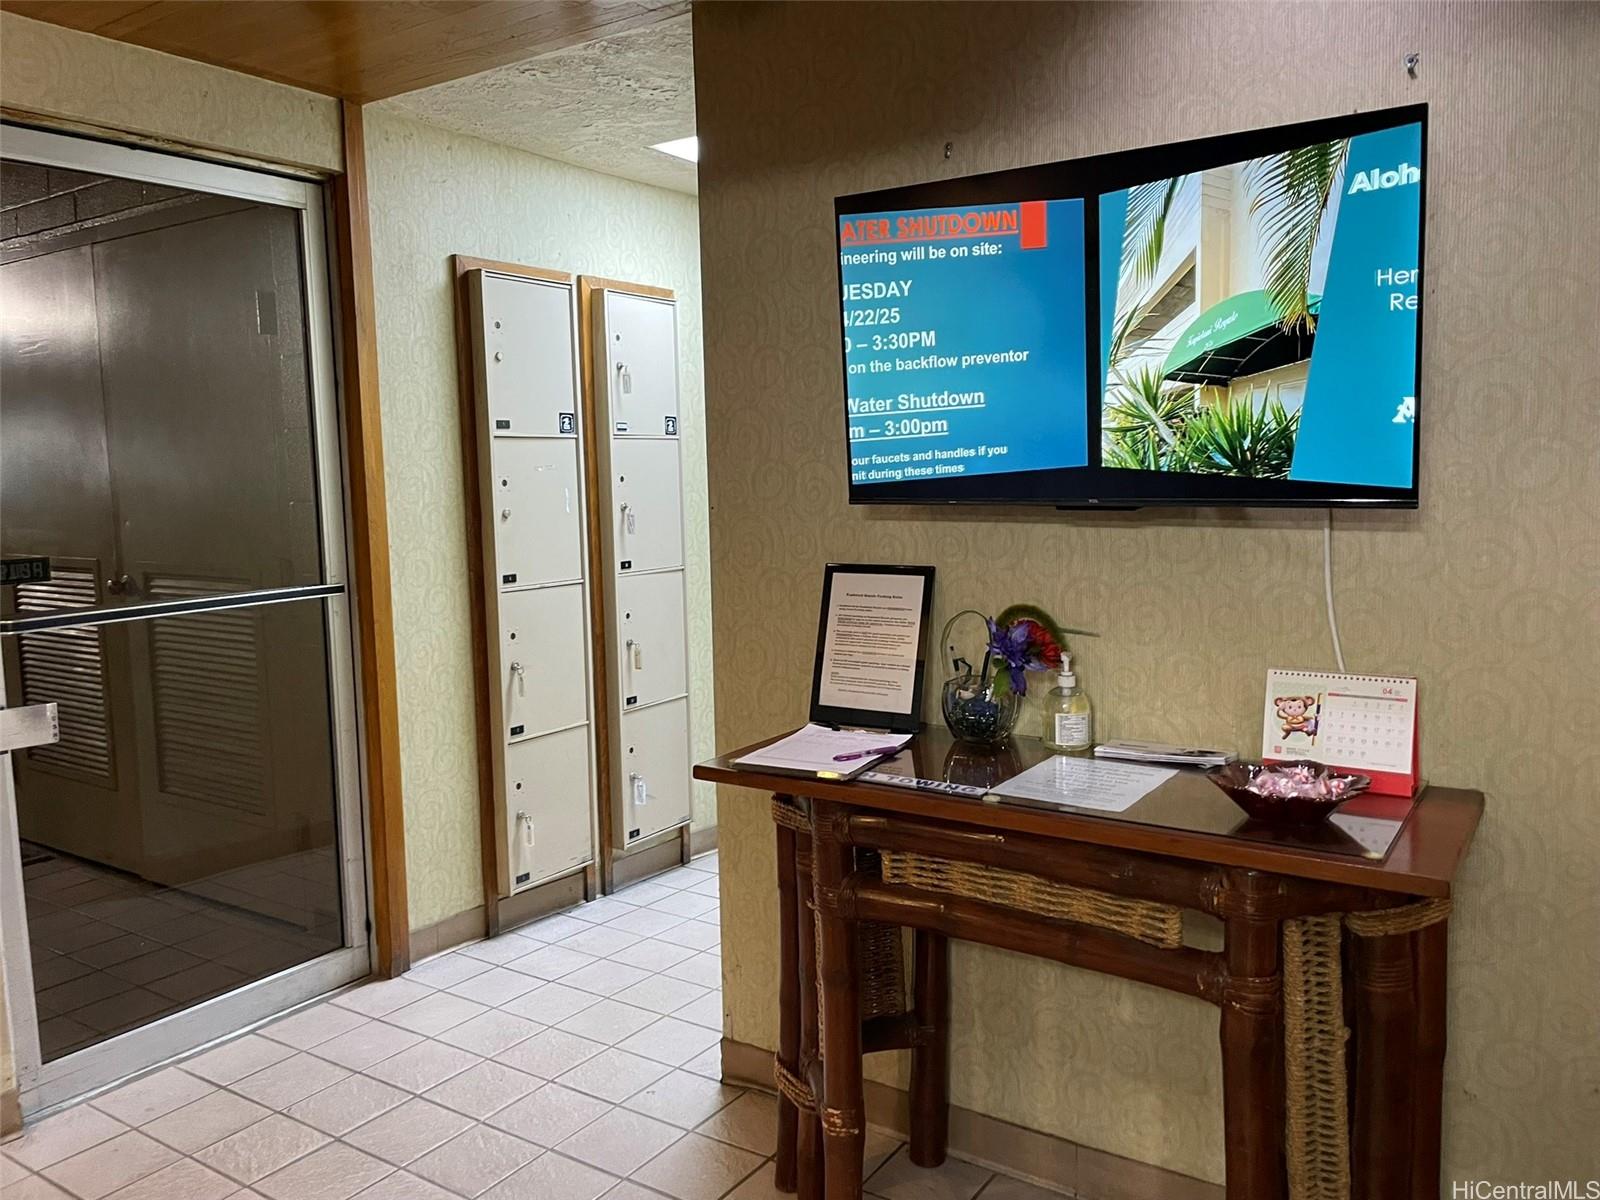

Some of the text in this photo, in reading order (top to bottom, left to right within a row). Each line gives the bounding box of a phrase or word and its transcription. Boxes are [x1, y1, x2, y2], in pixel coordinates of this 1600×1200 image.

[840, 209, 1019, 241] ATER SHUTDOWN
[900, 246, 925, 262] will
[929, 245, 947, 260] be
[950, 246, 969, 258] on
[972, 242, 1003, 256] site:
[872, 331, 936, 351] 3:30PM
[849, 350, 1029, 374] on the backflow preventor
[898, 390, 985, 411] Shutdown
[884, 418, 948, 436] 3:00pm
[872, 451, 910, 465] faucets
[912, 450, 932, 462] and
[934, 447, 976, 460] handles
[978, 445, 987, 457] if
[987, 445, 1008, 458] you
[868, 466, 902, 481] during
[904, 465, 933, 477] these
[935, 463, 965, 475] times
[887, 775, 977, 793] TOWING
